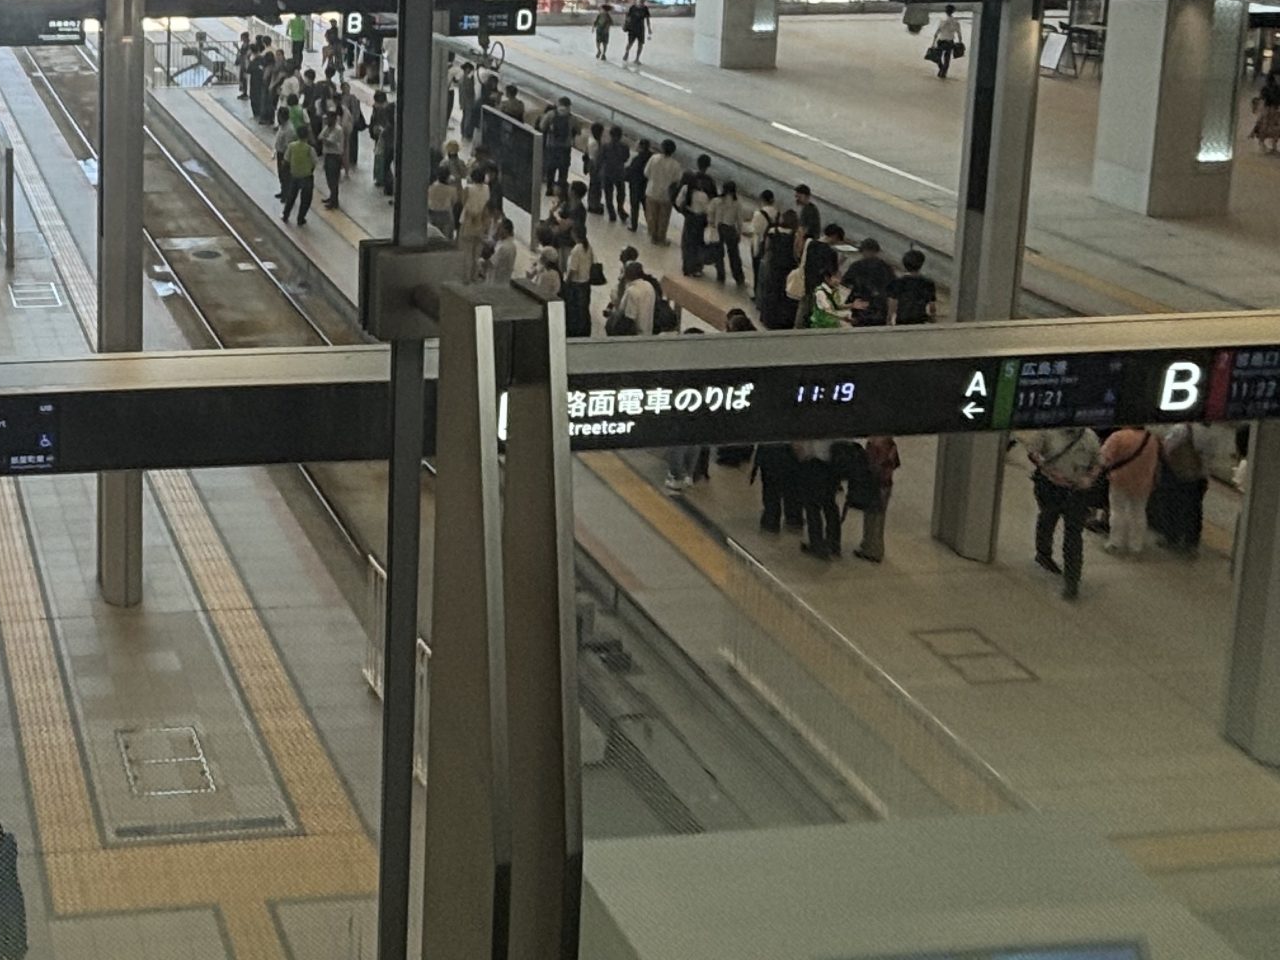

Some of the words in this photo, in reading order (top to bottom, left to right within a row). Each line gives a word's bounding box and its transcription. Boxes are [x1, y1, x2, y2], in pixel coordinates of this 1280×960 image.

[347, 12, 362, 34] B
[516, 9, 533, 31] D
[796, 382, 856, 403] 11:19
[965, 370, 987, 397] A
[1159, 361, 1201, 411] B
[567, 383, 755, 419] 路面電車のりば
[1018, 389, 1063, 407] 11:21
[568, 420, 635, 436] treetcar
